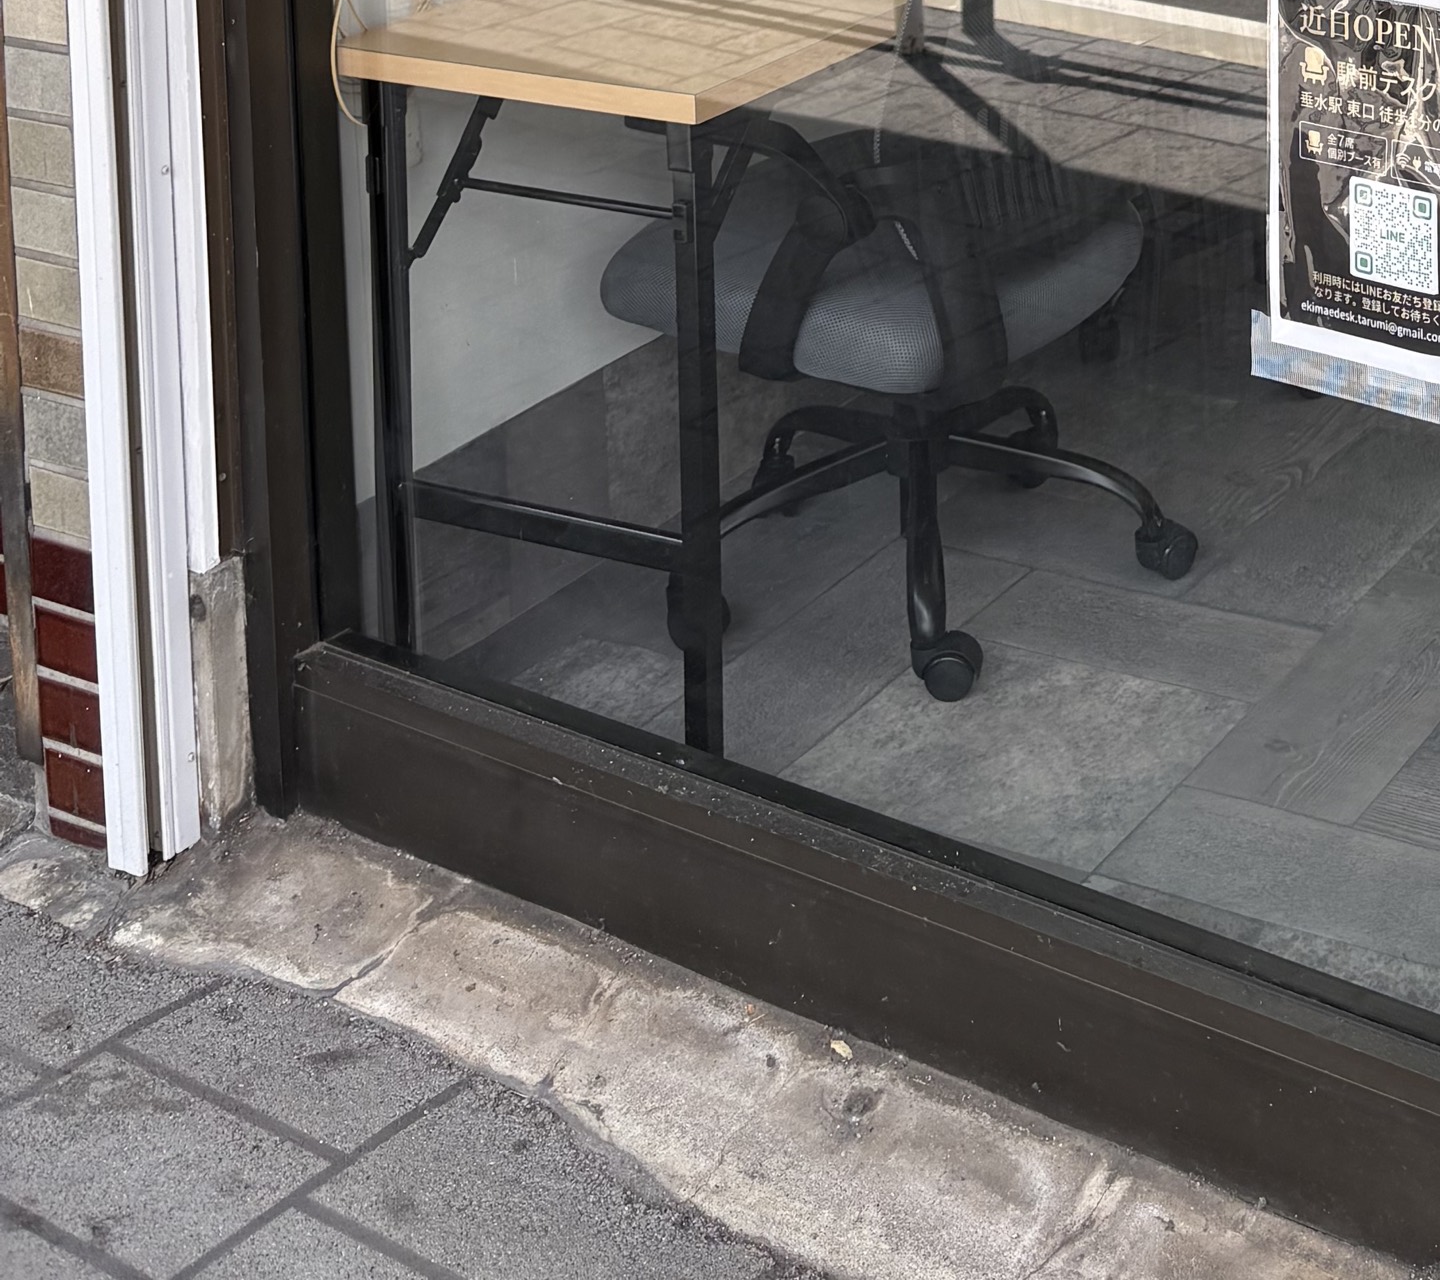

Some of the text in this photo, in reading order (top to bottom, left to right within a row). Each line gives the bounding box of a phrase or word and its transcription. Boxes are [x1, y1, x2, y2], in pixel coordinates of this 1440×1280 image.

[1300, 91, 1343, 115] 垂水駅
[1347, 99, 1376, 121] 東口
[1327, 132, 1355, 149] 全7席
[1379, 228, 1406, 244] LINE
